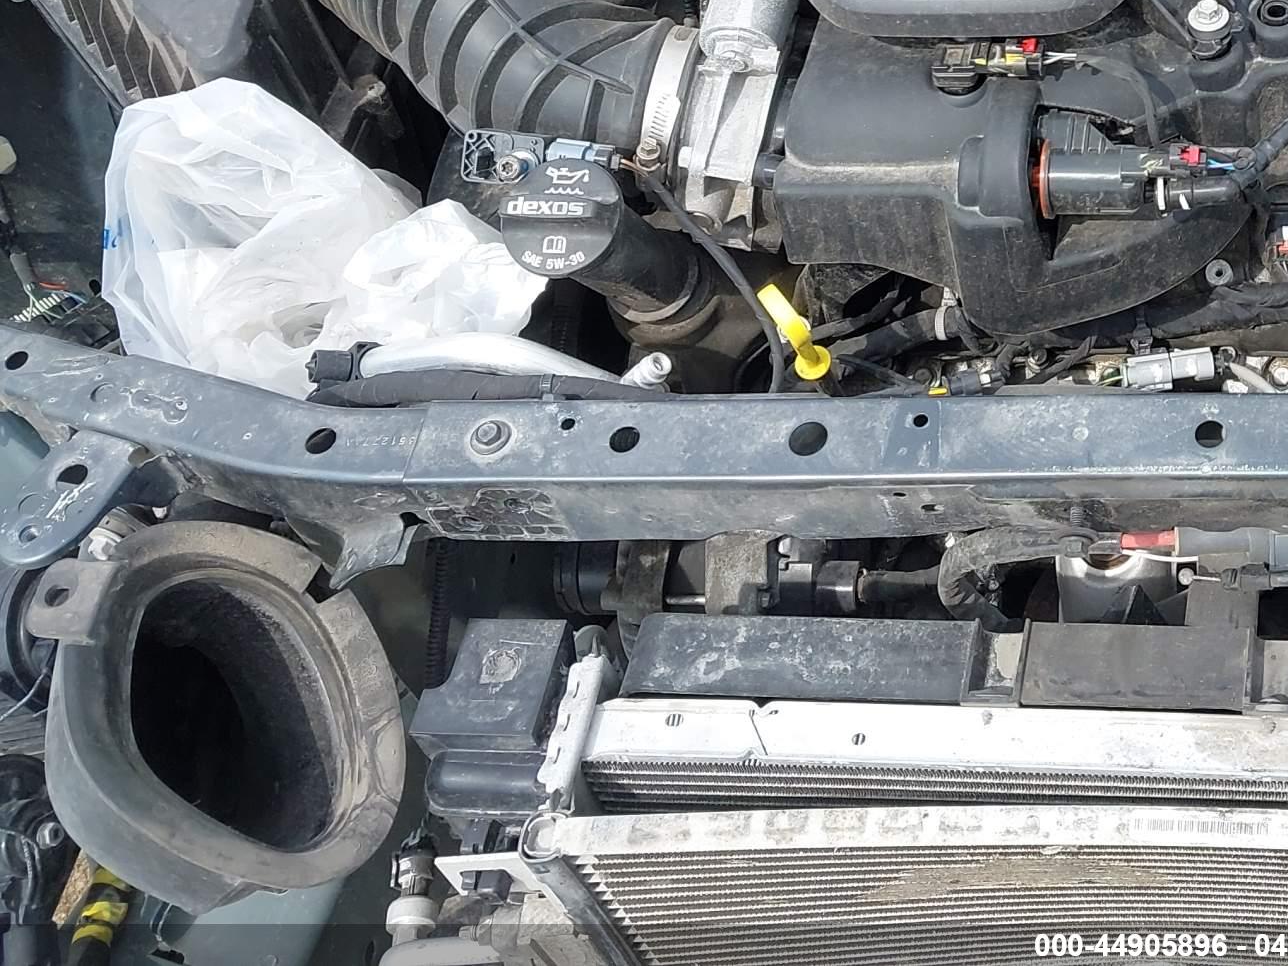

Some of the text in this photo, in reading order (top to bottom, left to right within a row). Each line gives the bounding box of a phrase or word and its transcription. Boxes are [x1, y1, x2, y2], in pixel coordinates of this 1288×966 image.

[506, 196, 588, 216] dexos
[521, 250, 586, 270] SAE 5W-30
